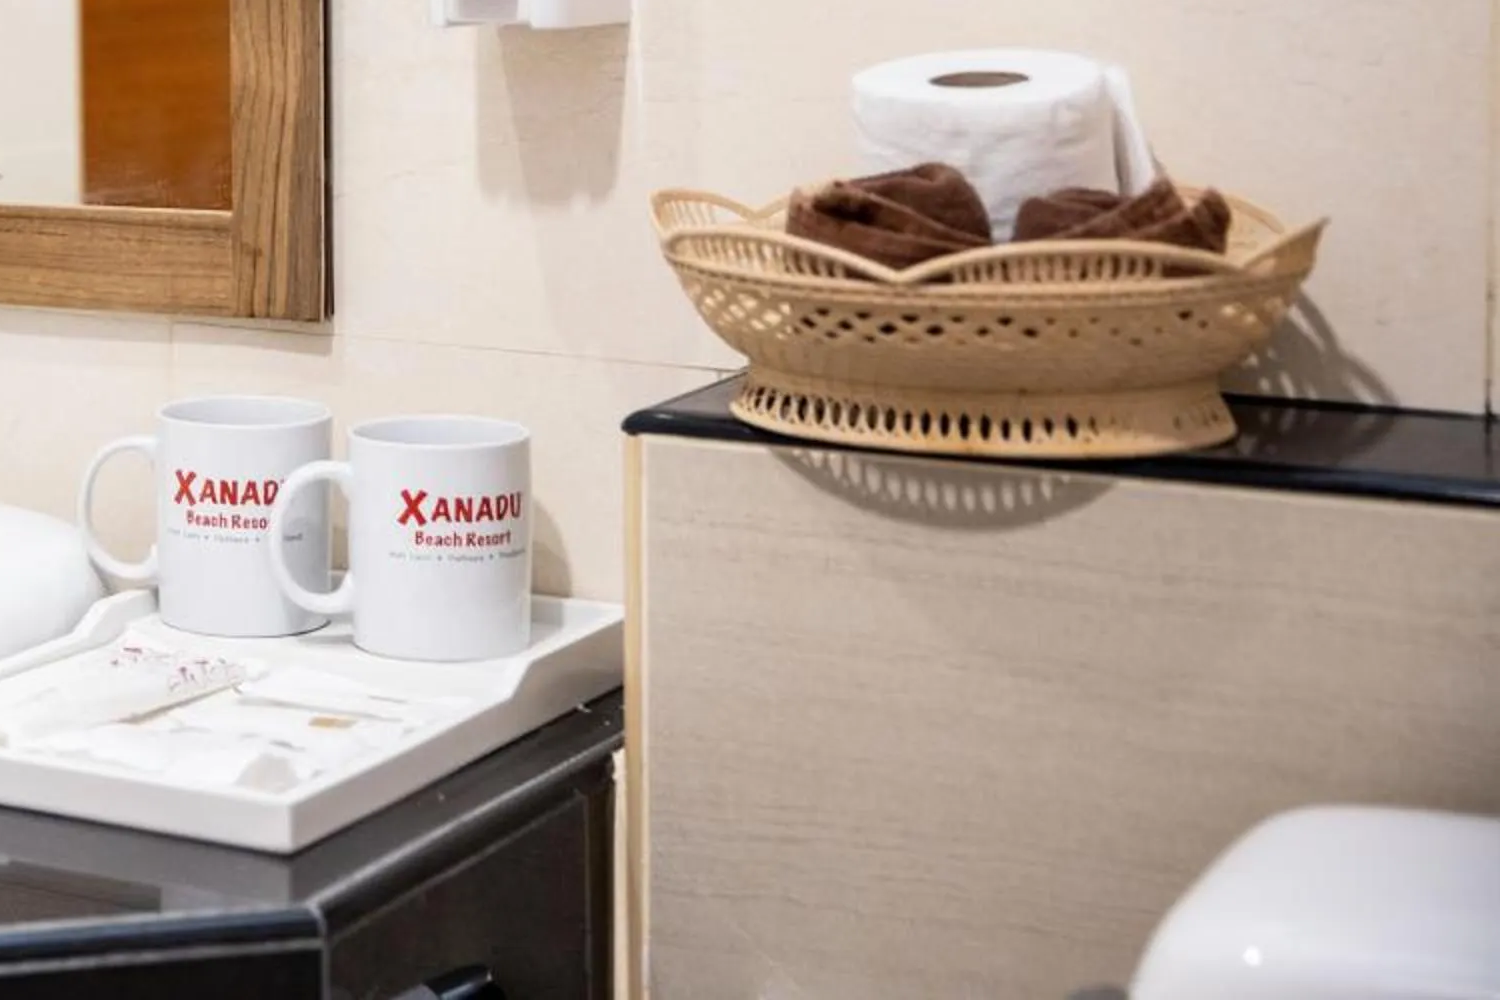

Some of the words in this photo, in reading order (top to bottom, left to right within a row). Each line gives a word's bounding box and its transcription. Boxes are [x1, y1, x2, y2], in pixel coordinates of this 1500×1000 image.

[174, 469, 284, 507] XANAD
[186, 510, 228, 529] Beach
[231, 514, 269, 530] Reso
[397, 488, 522, 527] XANADU
[415, 530, 463, 547] Beach
[465, 529, 512, 547] Resort
